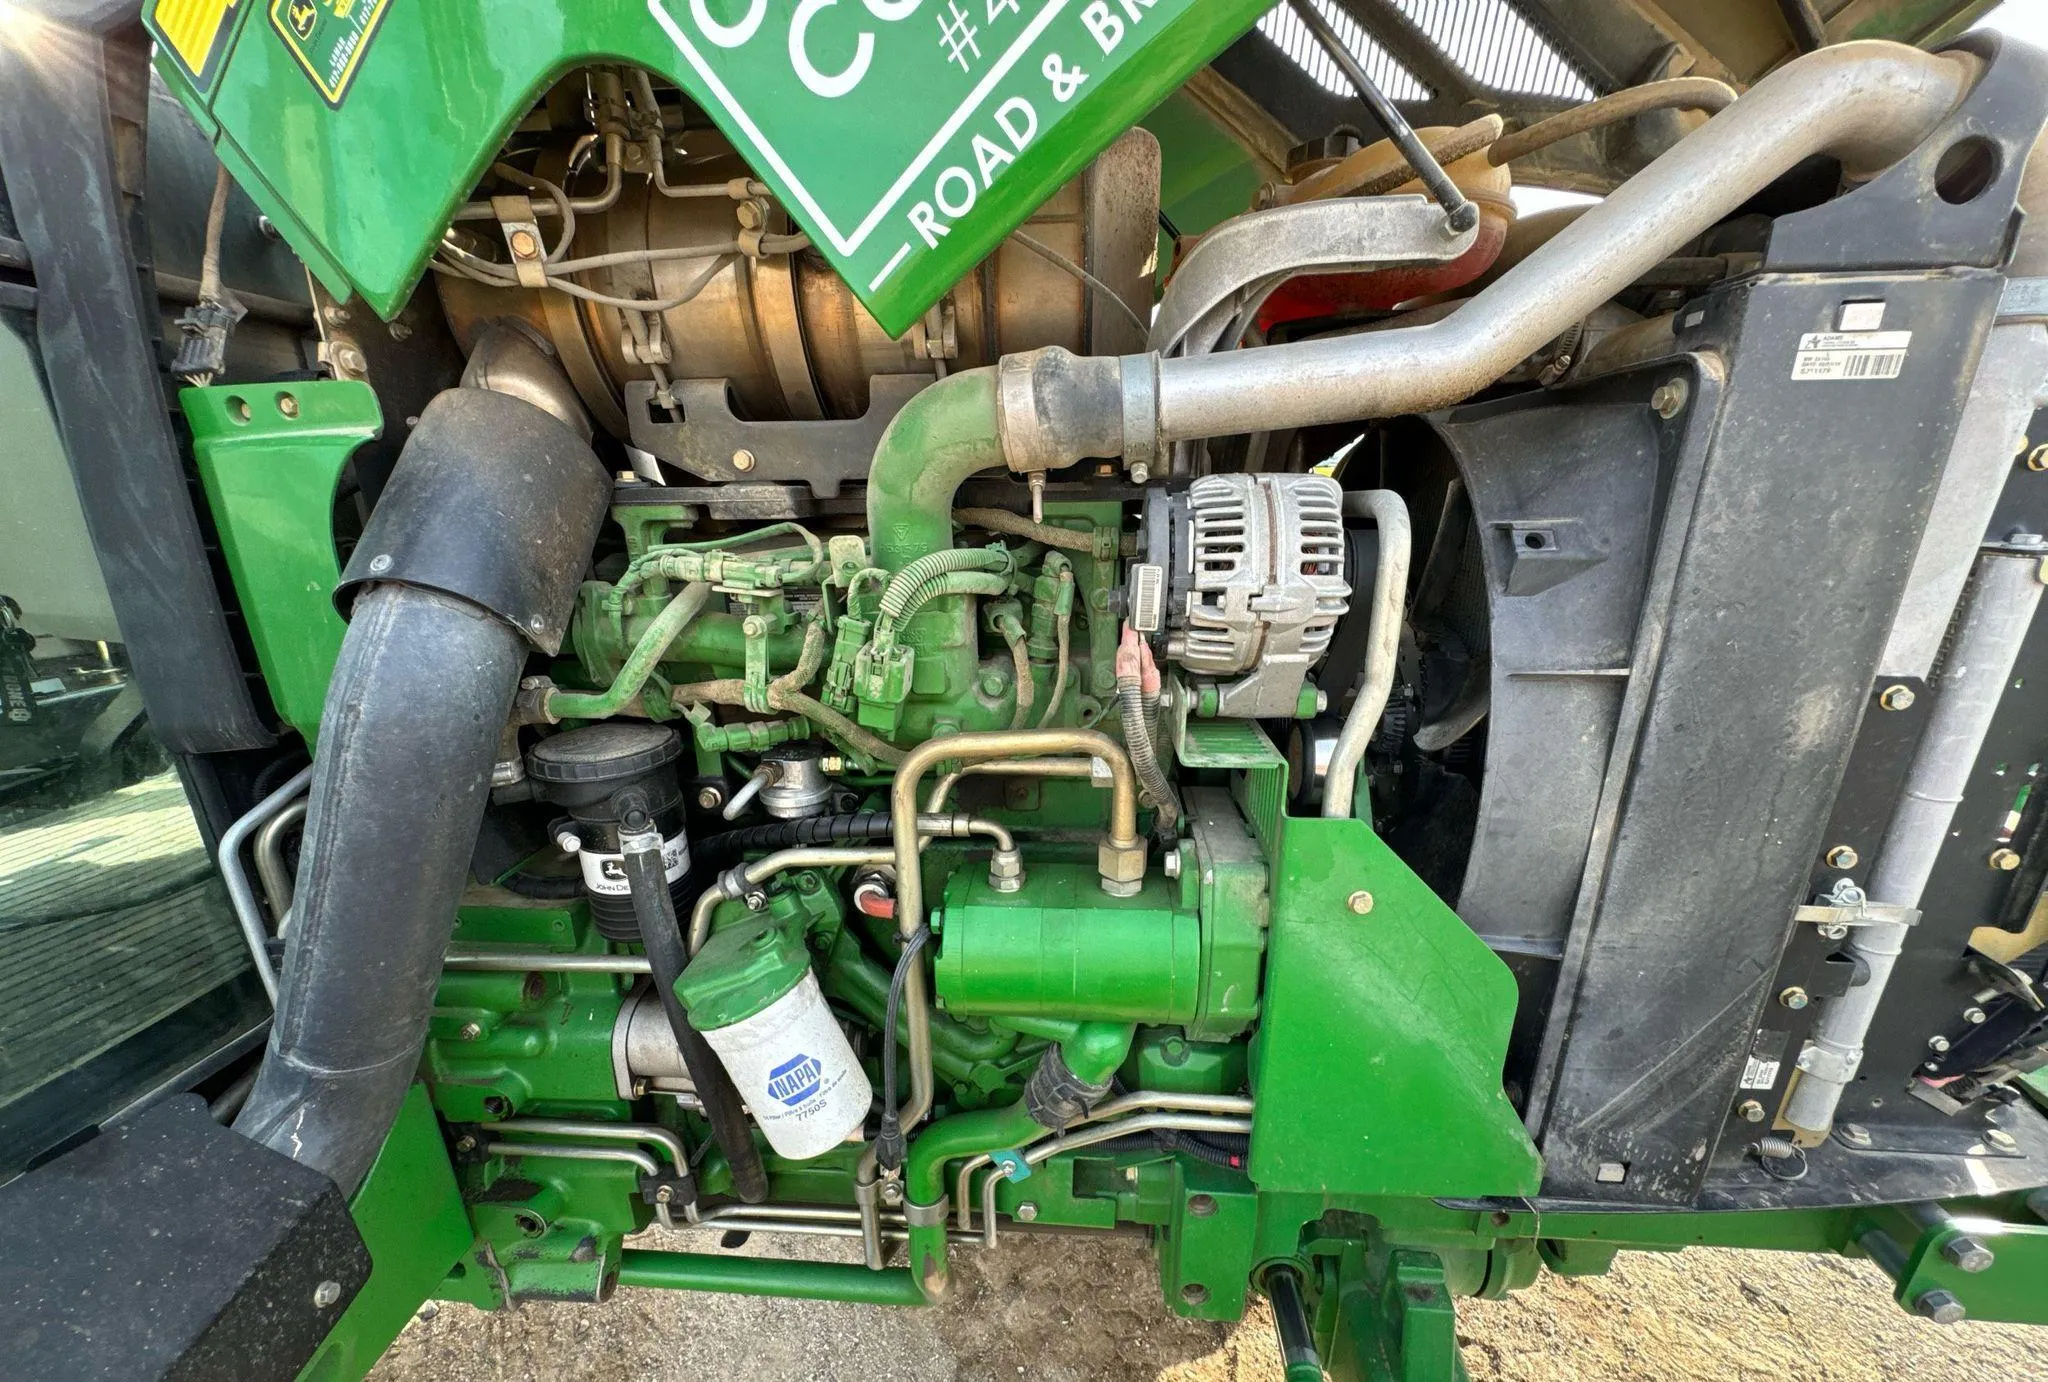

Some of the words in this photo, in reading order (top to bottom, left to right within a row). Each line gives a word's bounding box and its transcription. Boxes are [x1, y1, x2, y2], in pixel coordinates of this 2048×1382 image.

[907, 96, 1038, 250] ROAD
[1042, 52, 1090, 103] &
[774, 1063, 817, 1098] NAPA
[796, 1099, 827, 1122] 7750S
